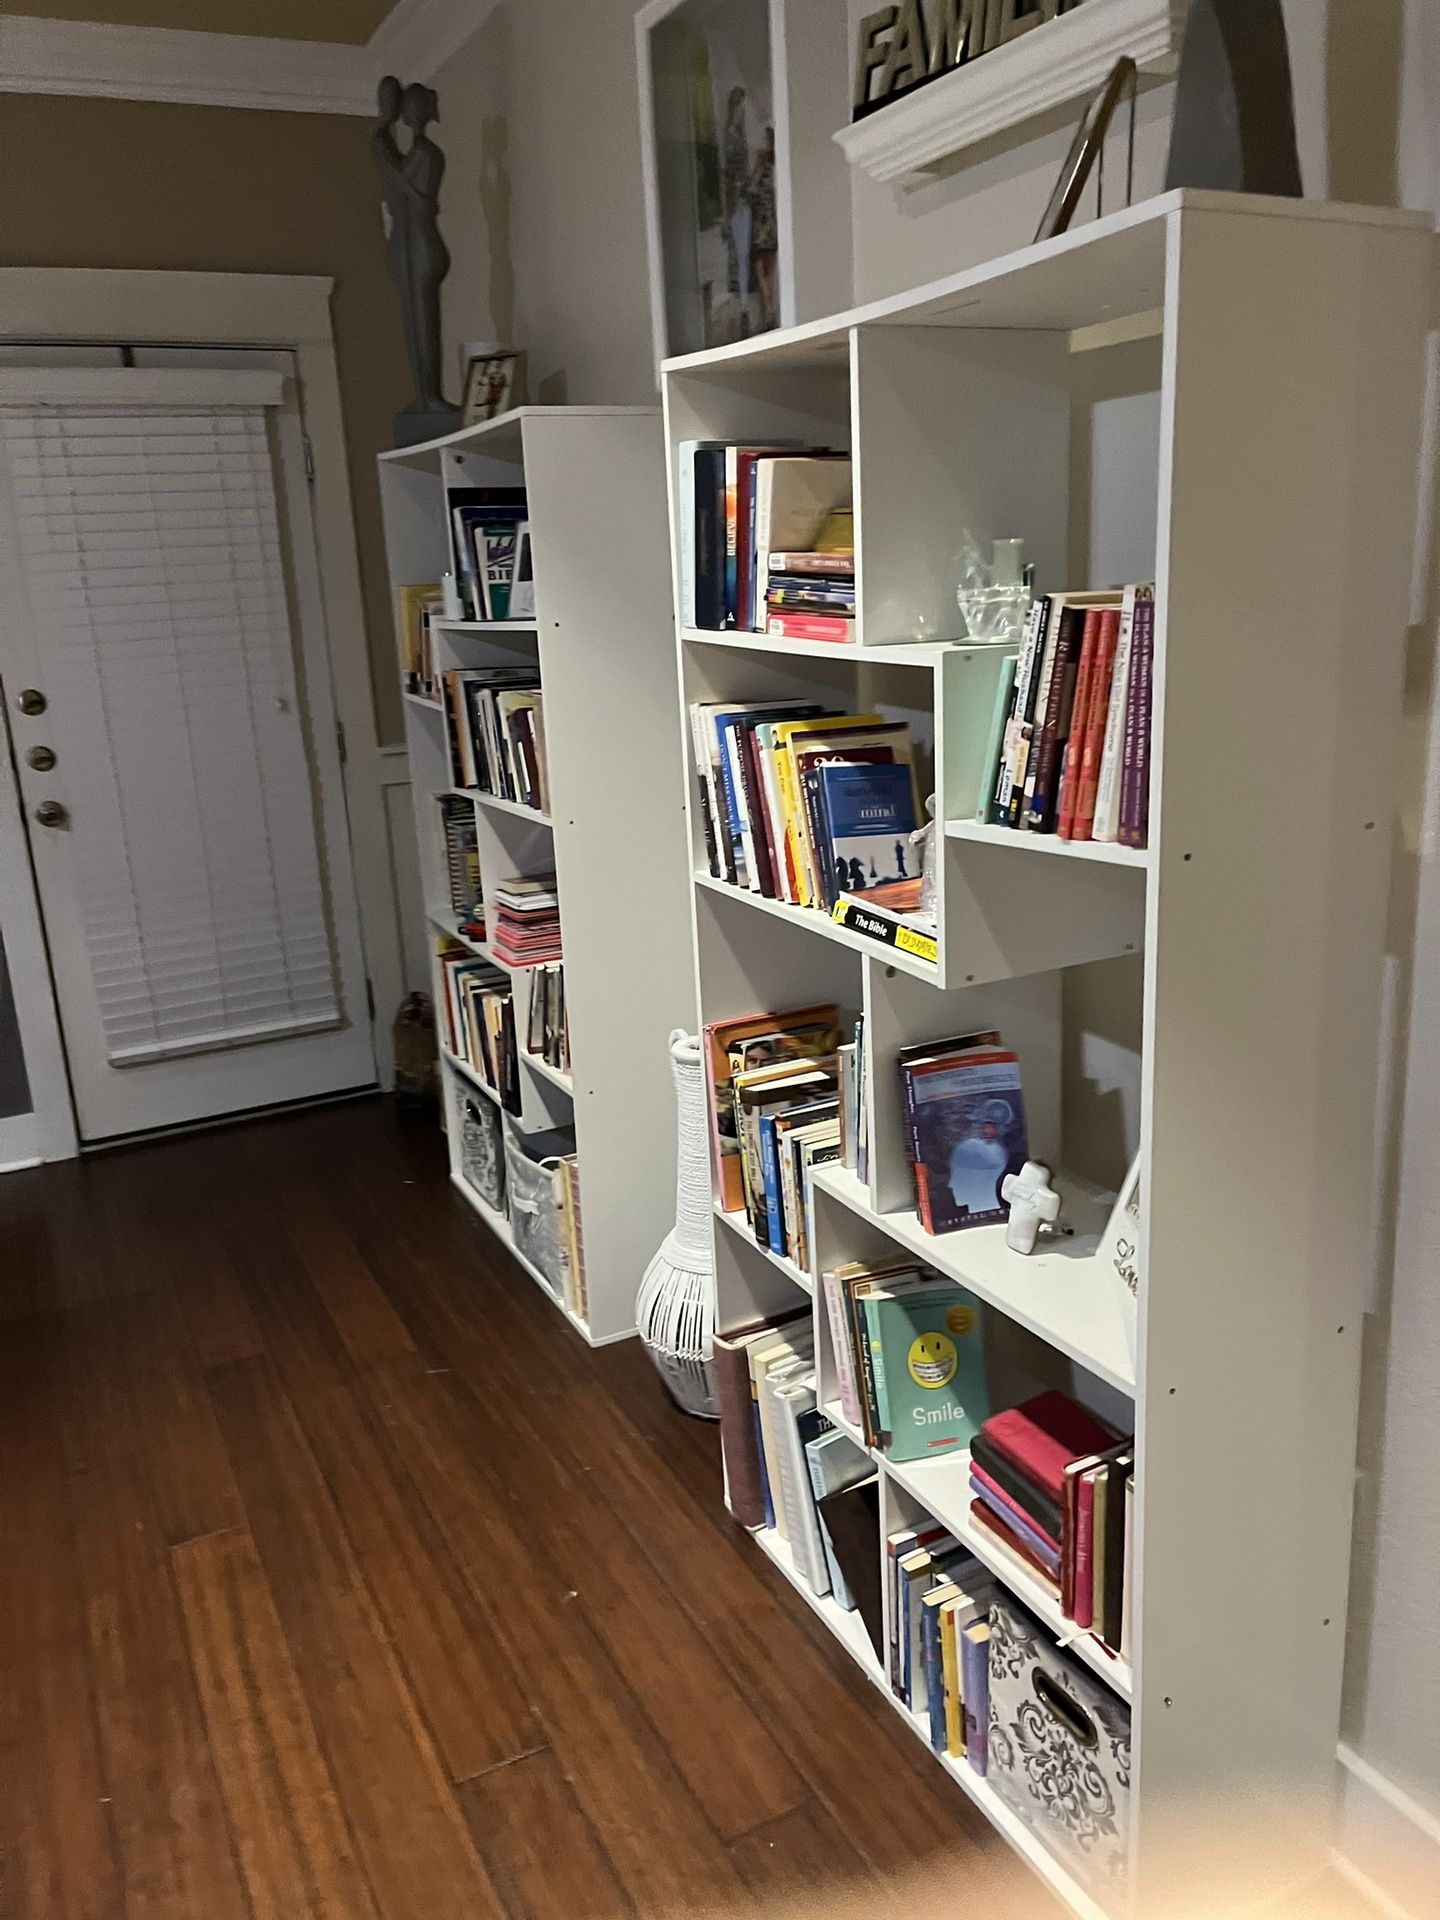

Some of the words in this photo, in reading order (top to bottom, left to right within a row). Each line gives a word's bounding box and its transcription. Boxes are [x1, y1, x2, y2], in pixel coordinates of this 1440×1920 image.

[1025, 645, 1033, 667] New
[1017, 670, 1029, 713] Husband
[1104, 703, 1121, 752] Syndrome
[1001, 769, 1012, 803] Leman
[855, 914, 868, 929] The
[868, 920, 888, 937] Bible
[872, 1358, 886, 1389] Smile
[912, 1402, 965, 1426] Smile
